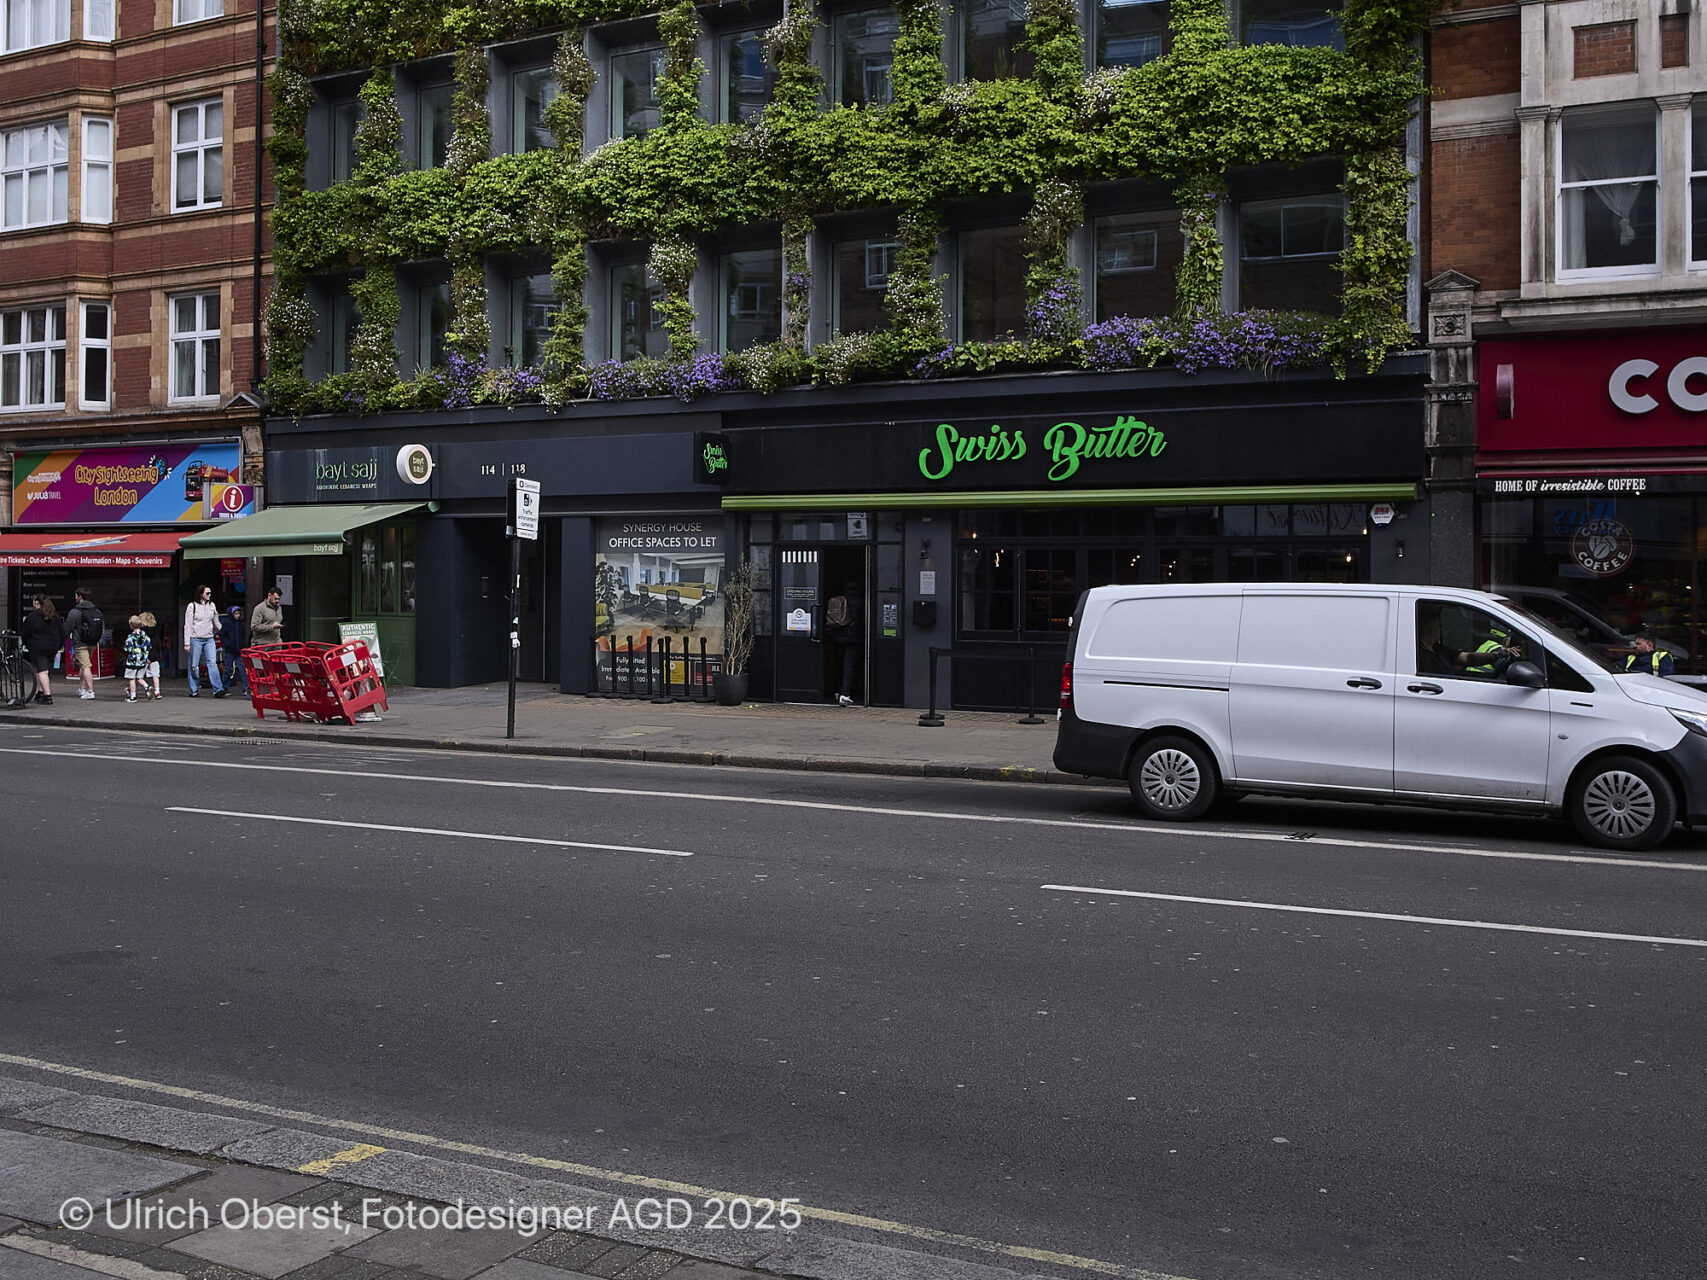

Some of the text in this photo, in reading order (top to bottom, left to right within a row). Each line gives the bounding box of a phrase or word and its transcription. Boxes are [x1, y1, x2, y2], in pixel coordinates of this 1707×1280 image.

[919, 415, 1168, 481] Swiss Butter
[75, 464, 96, 486] City
[96, 464, 159, 486] Sightseeing
[316, 458, 377, 481] bayt sajj
[481, 463, 526, 475] 114 118
[1495, 478, 1646, 492] HOME OF irresistible COFFEE
[94, 486, 138, 506] London
[623, 522, 702, 532] SYNERGY HOUSE
[313, 544, 328, 552] bayt
[608, 536, 717, 548] OFFICE SPACES TO LET
[8, 556, 26, 564] Tickets
[29, 556, 62, 564] Out-of-Town
[62, 556, 77, 564] Tours
[80, 556, 111, 564] Information
[115, 556, 131, 565] Maps
[134, 557, 163, 565] Souvenirs
[1577, 551, 1628, 571] COFFEE
[342, 623, 375, 631] AUTHENTIC
[616, 656, 629, 665] Fully
